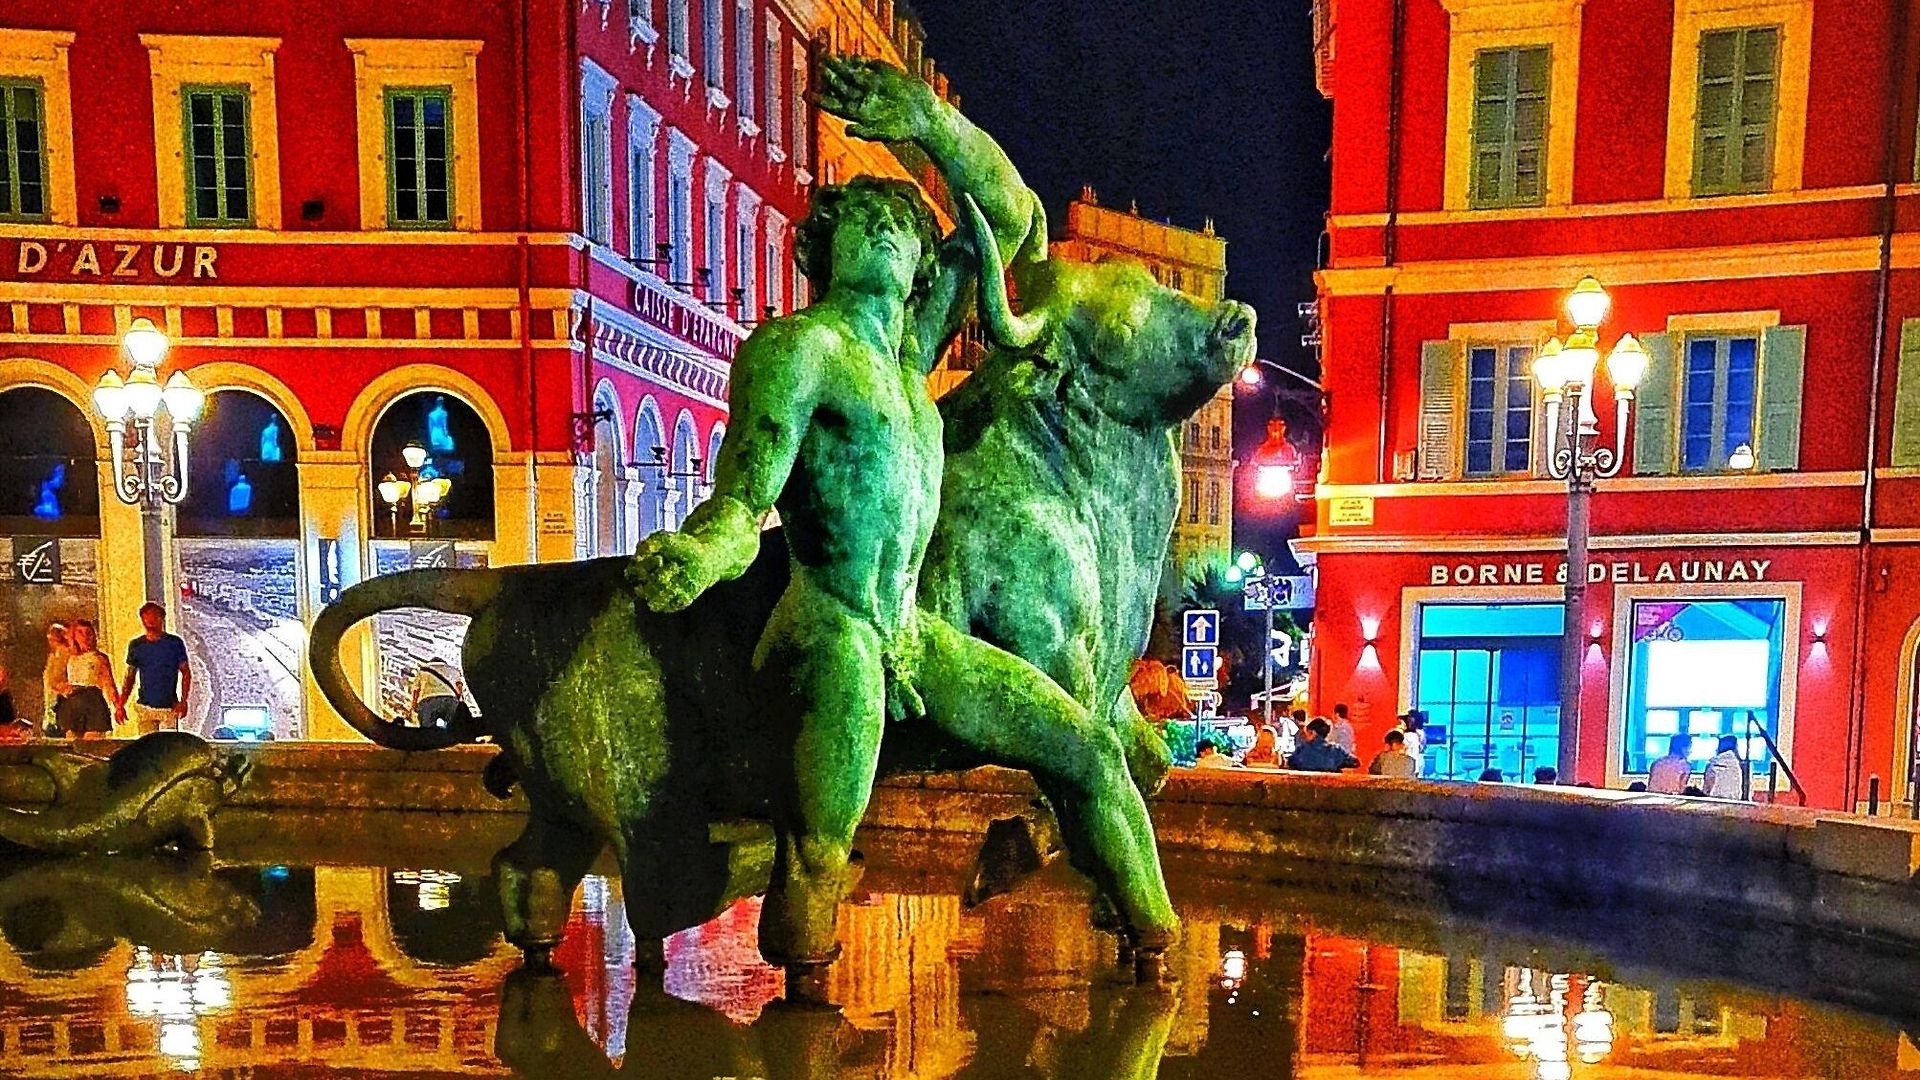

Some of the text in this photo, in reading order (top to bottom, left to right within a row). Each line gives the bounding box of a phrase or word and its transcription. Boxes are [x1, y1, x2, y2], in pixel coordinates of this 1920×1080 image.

[18, 241, 218, 278] D'AZUR
[634, 283, 674, 329] CAISSE
[1431, 560, 1772, 584] BORNE & DELAUNAY
